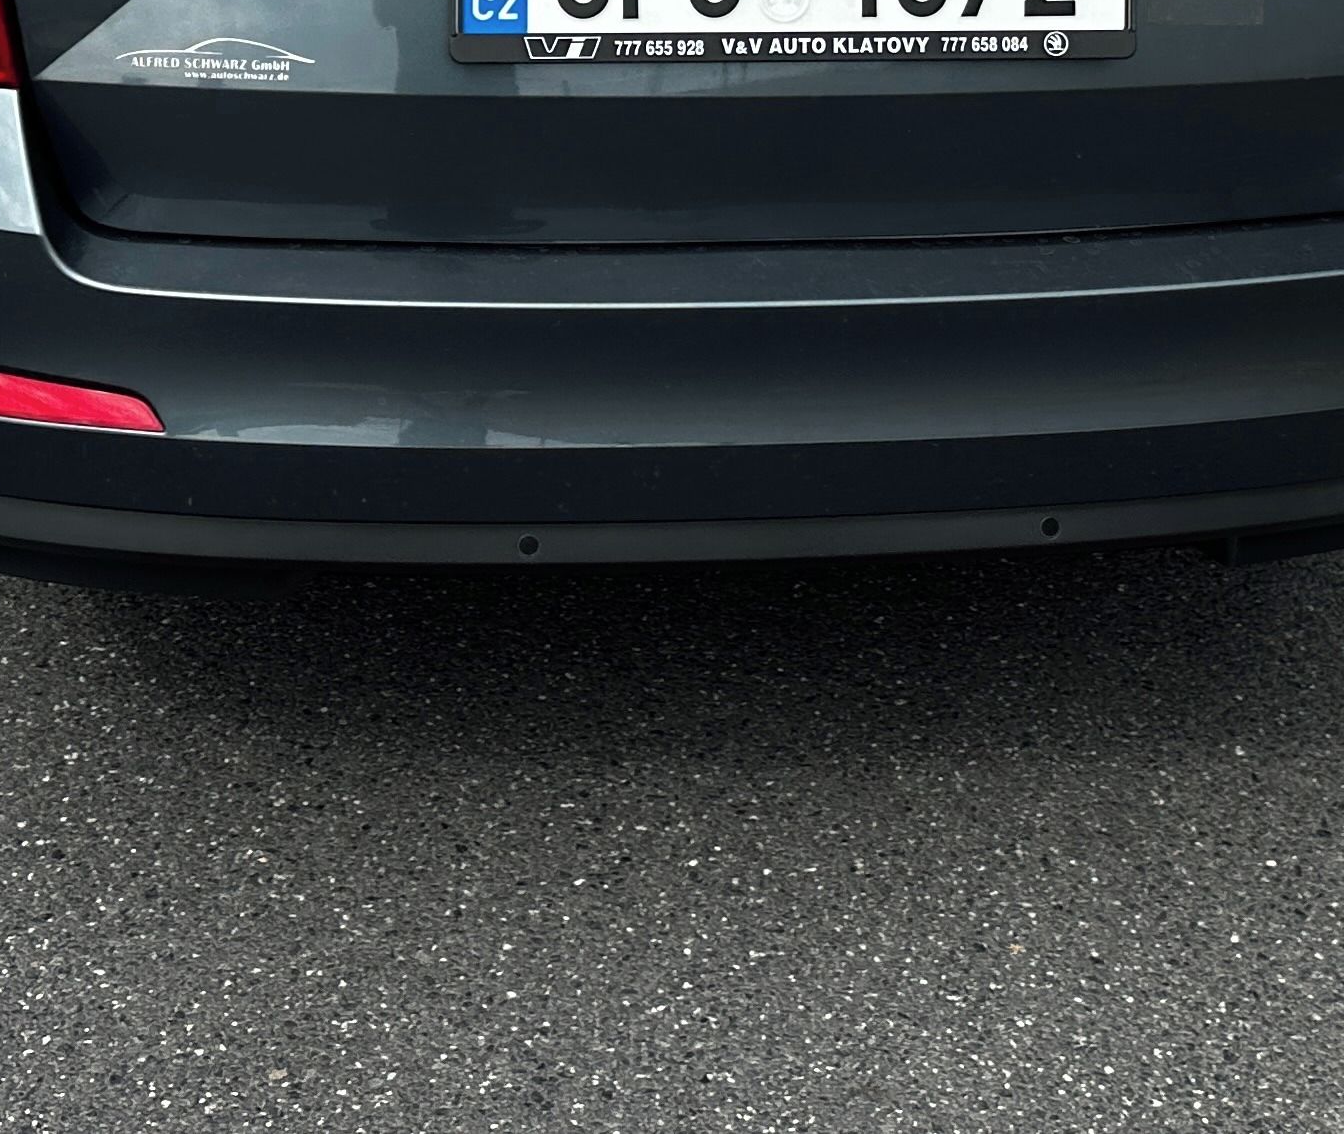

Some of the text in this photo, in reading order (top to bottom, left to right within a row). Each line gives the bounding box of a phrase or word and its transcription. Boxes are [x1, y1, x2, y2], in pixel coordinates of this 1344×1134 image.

[614, 36, 1028, 56] 777 655 928 V&V AUTO KLATOVY 777 658 084
[131, 56, 290, 71] ALFRED SCHWARZ GmbH
